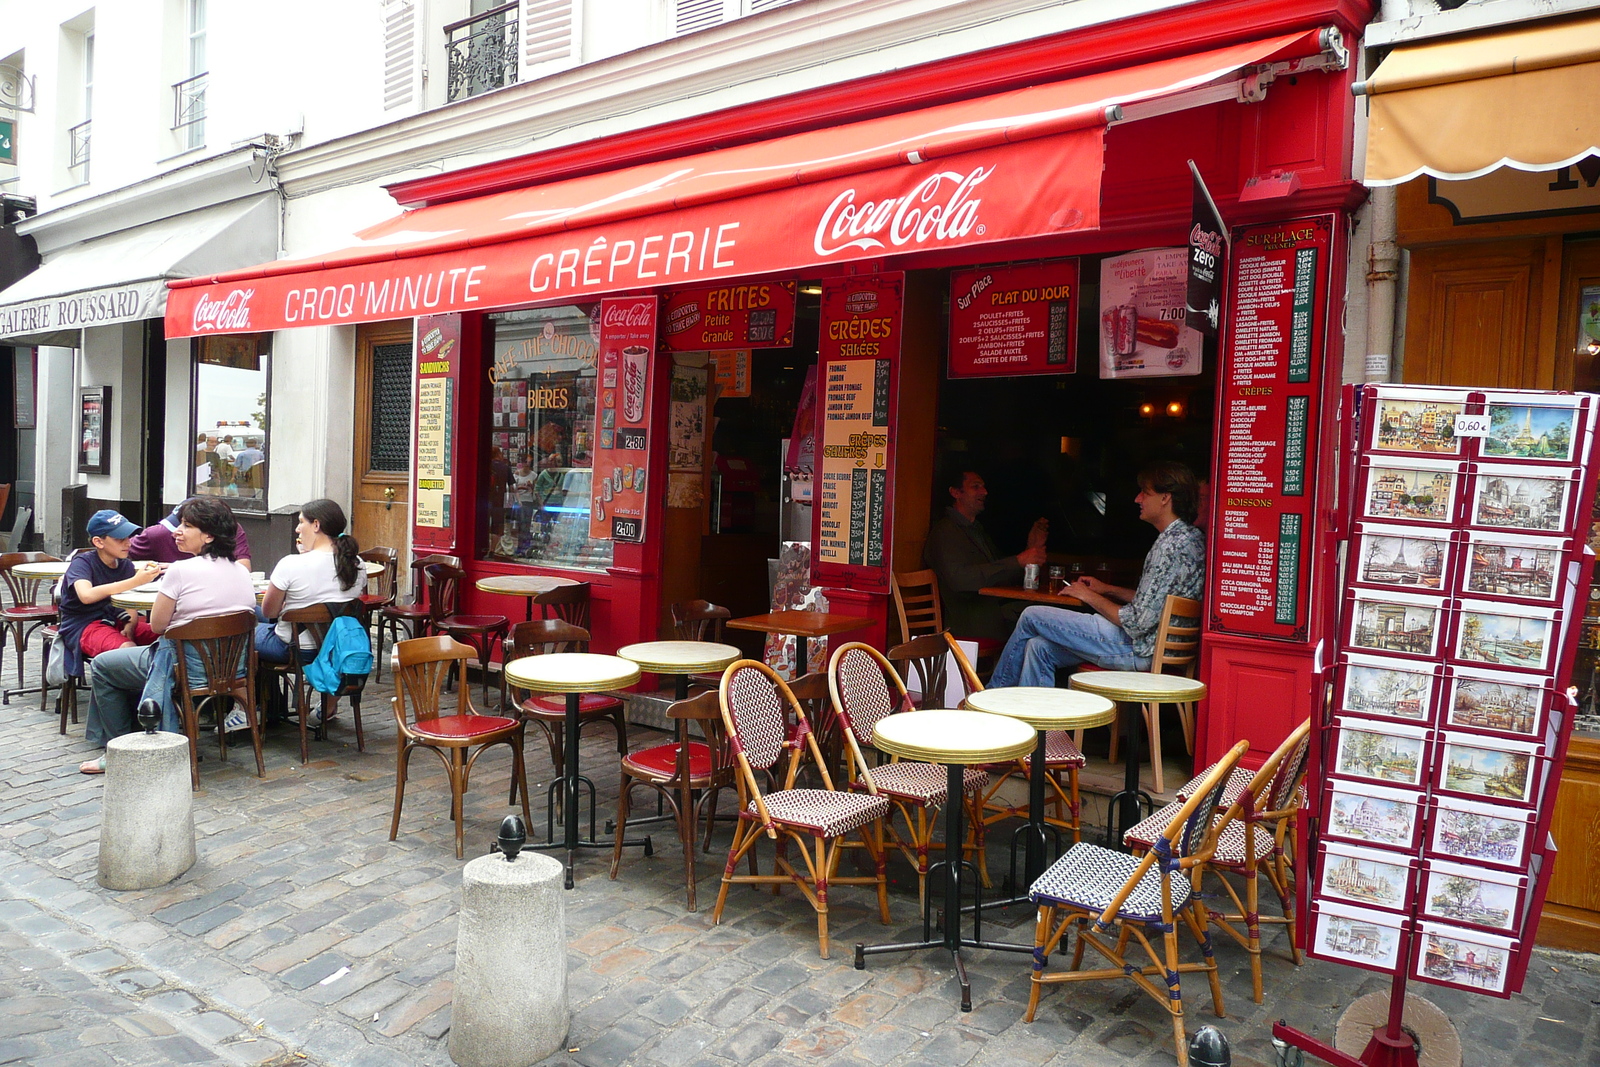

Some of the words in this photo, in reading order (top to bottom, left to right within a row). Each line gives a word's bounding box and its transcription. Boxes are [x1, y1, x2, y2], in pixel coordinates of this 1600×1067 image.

[814, 164, 997, 256] Coca-Cola
[1247, 234, 1270, 247] SUR
[1273, 228, 1314, 243] PLACE
[529, 222, 741, 293] CRÊPERIE
[1194, 248, 1214, 268] zero
[286, 266, 486, 322] CROQ'MINUTE
[707, 286, 770, 311] FRITES
[958, 293, 972, 310] Sur
[971, 275, 992, 298] Place
[992, 291, 1019, 305] PLAT
[1022, 288, 1038, 302] DU
[1041, 286, 1070, 300] JOUR
[0, 304, 50, 335] GALERIE
[58, 290, 140, 326] ROUSSARD
[604, 302, 653, 327] Coca-Cola
[705, 314, 730, 327] Petite
[1160, 308, 1185, 320] 7,00
[702, 330, 734, 343] Grande
[829, 315, 891, 340] CRÊPES
[840, 340, 879, 356] SALÉES
[488, 345, 517, 385] CAFÉ
[520, 333, 544, 359] THÉ
[528, 385, 568, 409] BIÈRES
[1239, 386, 1272, 396] CRÊPES
[1458, 420, 1480, 432] 0,60
[626, 436, 644, 449] 2,80
[849, 431, 887, 447] CRÊPES
[824, 445, 867, 458] GAUFRES
[1227, 498, 1272, 508] BOISSONS
[616, 522, 635, 536] 2,00
